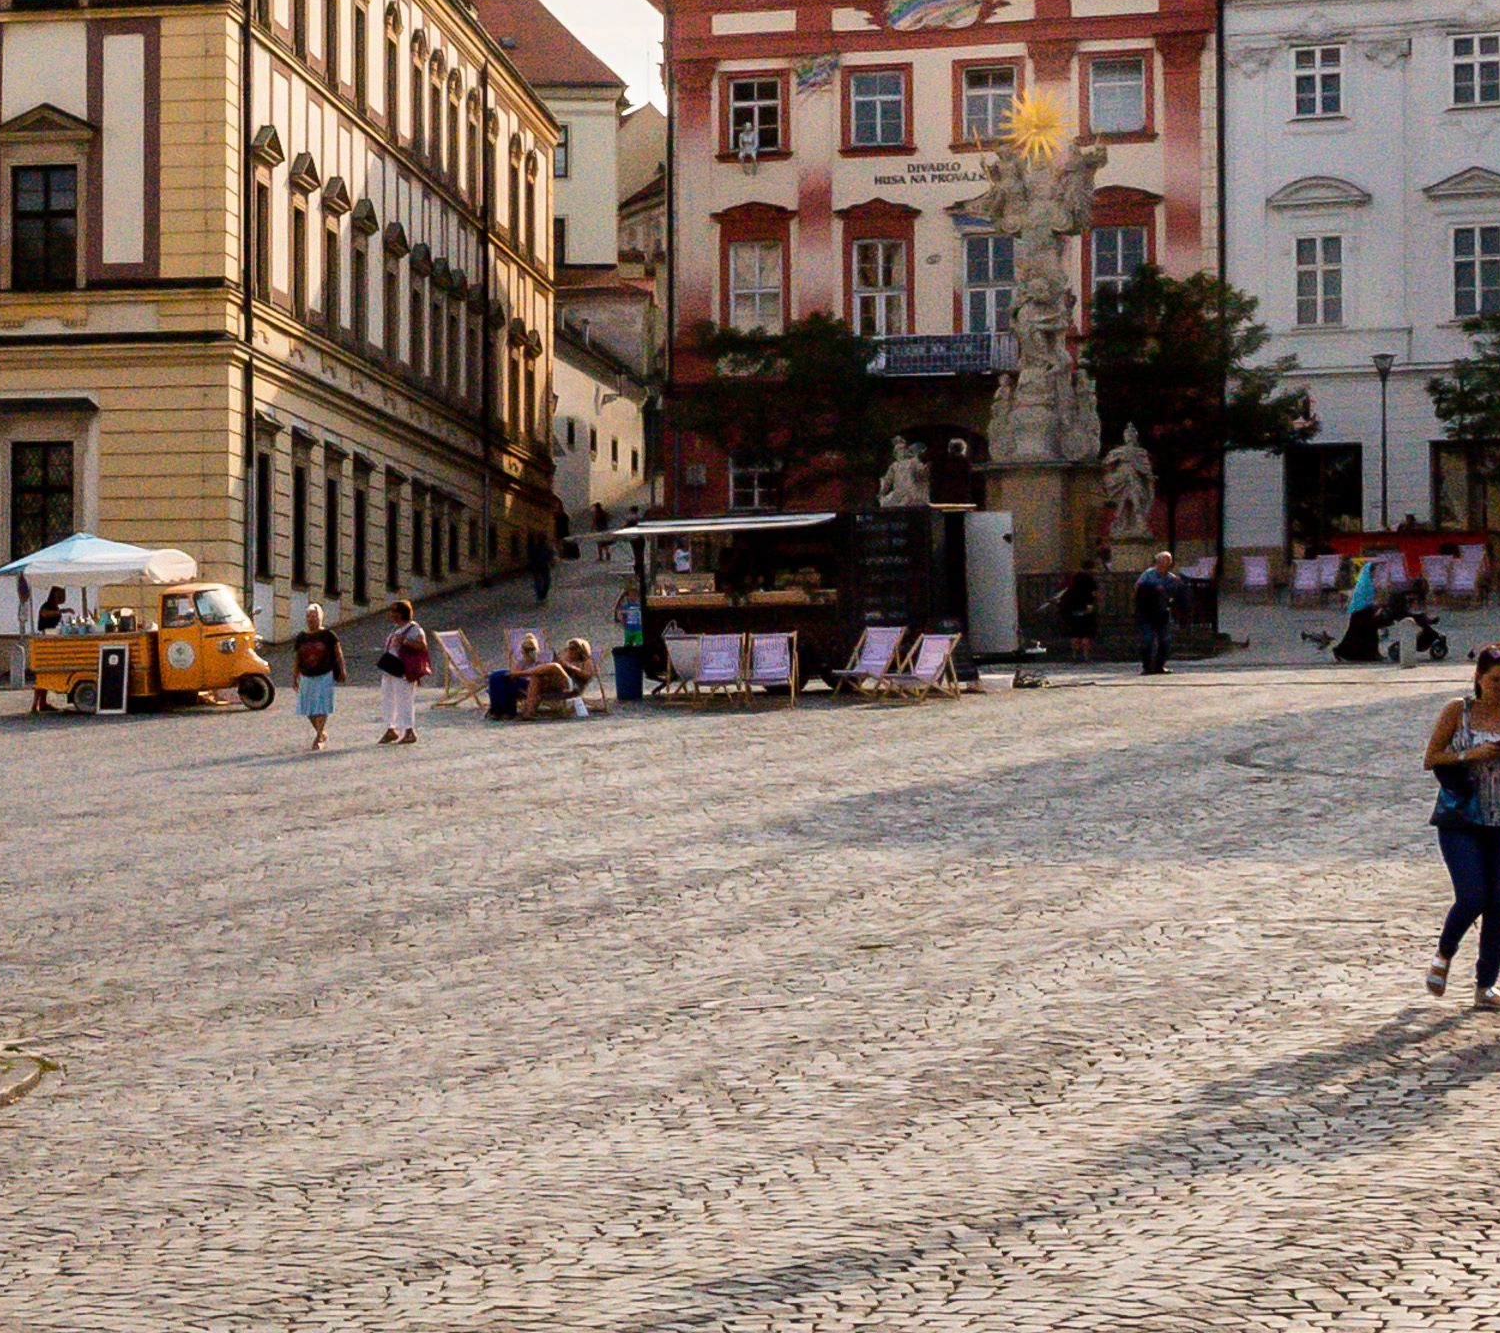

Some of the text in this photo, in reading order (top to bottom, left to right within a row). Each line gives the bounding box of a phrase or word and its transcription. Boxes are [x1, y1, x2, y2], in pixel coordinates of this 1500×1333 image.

[907, 161, 961, 174] DIVADLO
[874, 175, 906, 185] HUSA
[910, 173, 927, 183] NA
